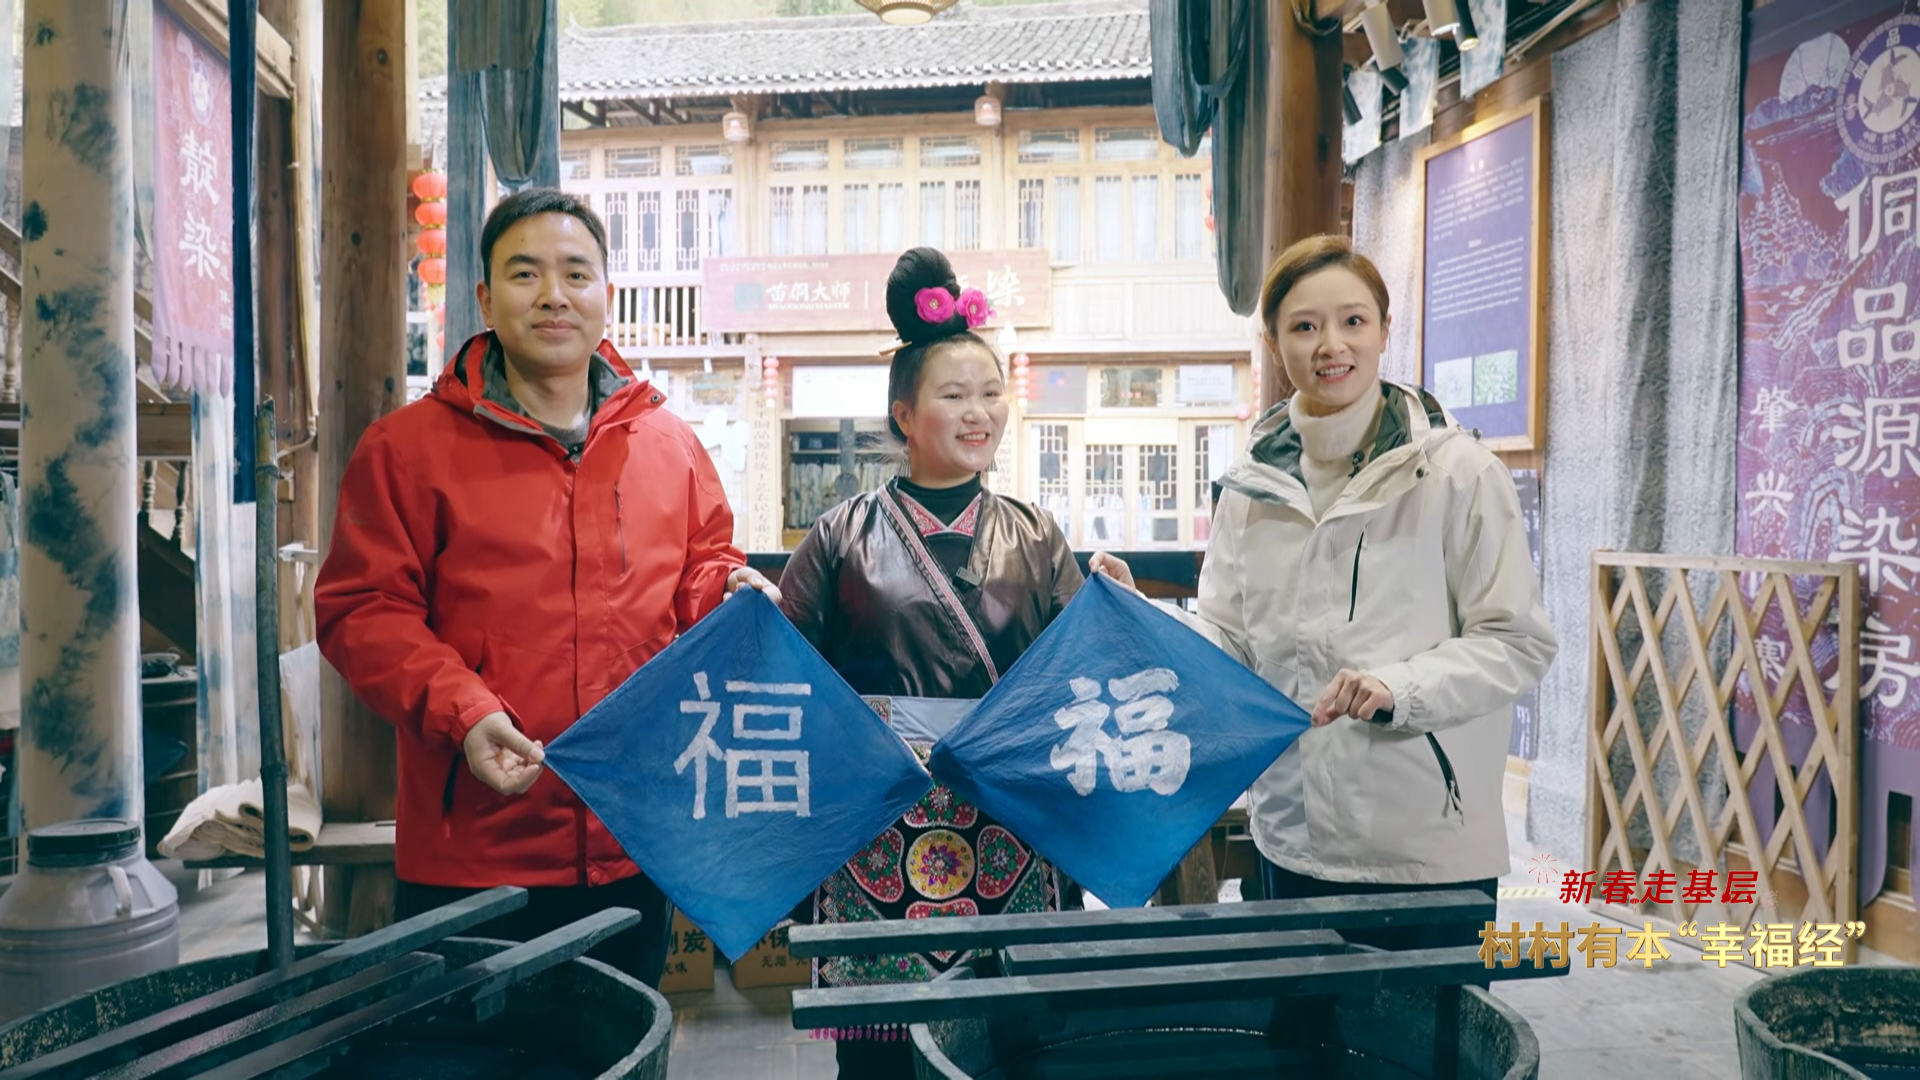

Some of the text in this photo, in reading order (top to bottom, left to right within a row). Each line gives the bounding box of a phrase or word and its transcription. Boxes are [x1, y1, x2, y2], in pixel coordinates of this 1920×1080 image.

[179, 127, 222, 281] 靛染
[766, 280, 851, 302] 苗侗大师
[1826, 168, 1920, 709] 侗品源染房
[673, 671, 811, 820] 福
[1050, 668, 1192, 796] 福
